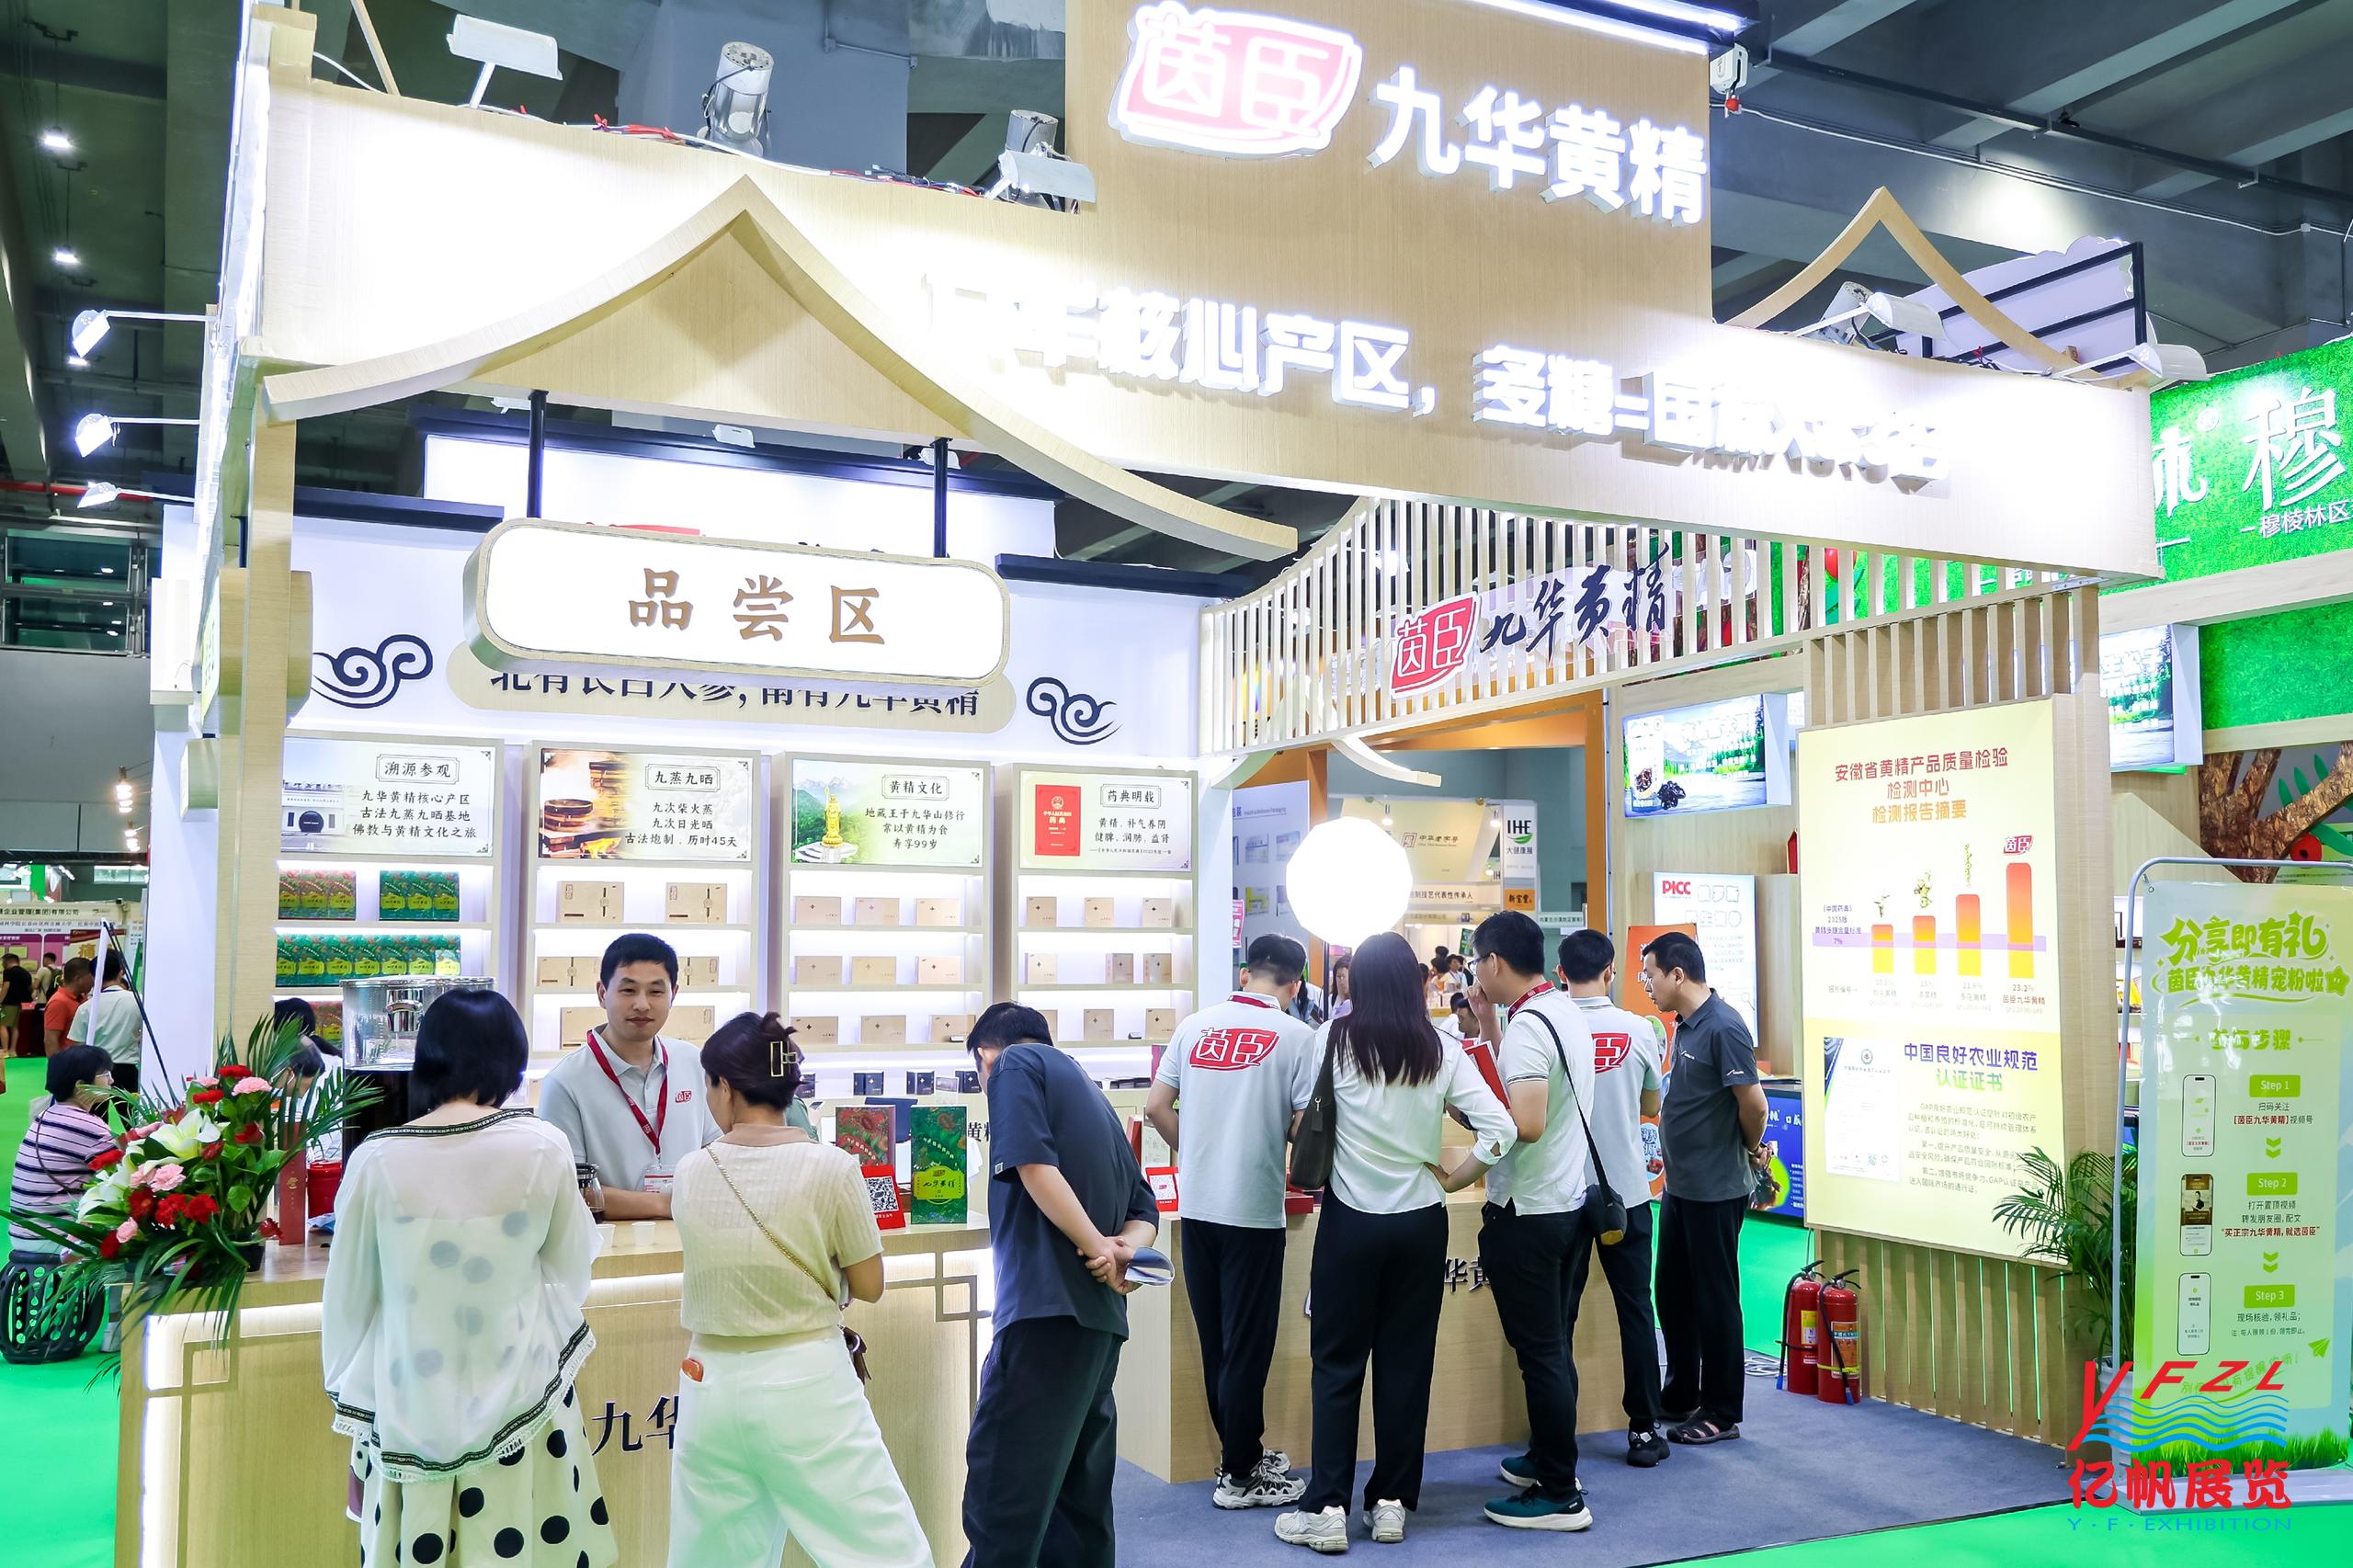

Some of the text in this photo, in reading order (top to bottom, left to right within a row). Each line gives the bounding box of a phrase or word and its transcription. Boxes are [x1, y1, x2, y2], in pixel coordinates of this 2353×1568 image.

[1136, 13, 1331, 140] 茵臣
[1366, 66, 1707, 227] 九华黄精
[2243, 387, 2346, 511] 穆
[2258, 499, 2353, 539] 穆棱林区
[629, 567, 885, 645] 品尝区
[1480, 542, 1670, 659] 九华黄精
[1394, 608, 1470, 680] 茵臣
[384, 762, 451, 778] 溯源参观
[1835, 747, 2008, 782] 安徽省黄精产品质量检验
[654, 770, 714, 786] 九蒸九晒
[890, 780, 942, 795] 黄精文化
[1887, 778, 1949, 800] 检测中心
[362, 790, 470, 805] 九华黄精核心产区
[1108, 790, 1154, 803] 药典明载
[360, 806, 471, 822] 古法九蒸九晒基地
[653, 801, 713, 815] 九次柴火蒸
[865, 807, 965, 822] 地藏王于九华山修行
[1872, 800, 1967, 824] 检测报告摘要
[352, 824, 477, 839] 佛教与黄精文化之旅
[653, 817, 713, 830] 九次日光晒
[882, 824, 948, 835] 常以黄精为食
[1507, 820, 1532, 835] IHE
[892, 838, 938, 850] 寿享99岁
[1662, 881, 1691, 895] PICC
[2161, 911, 2328, 965] 分享即有礼
[1195, 1027, 1271, 1066] 茵臣
[1593, 1036, 1624, 1068] 臣
[1904, 1042, 2038, 1071] 中国良好农业规范
[1936, 1068, 2003, 1092] 认证证书
[2260, 1080, 2290, 1092] Step 1
[2258, 1103, 2290, 1112] 扫码关注
[2257, 1177, 2287, 1190] Step 2
[2248, 1200, 2297, 1210] 打开置顶视频
[2256, 1290, 2284, 1303] Step 3
[591, 1395, 679, 1457] 九华
